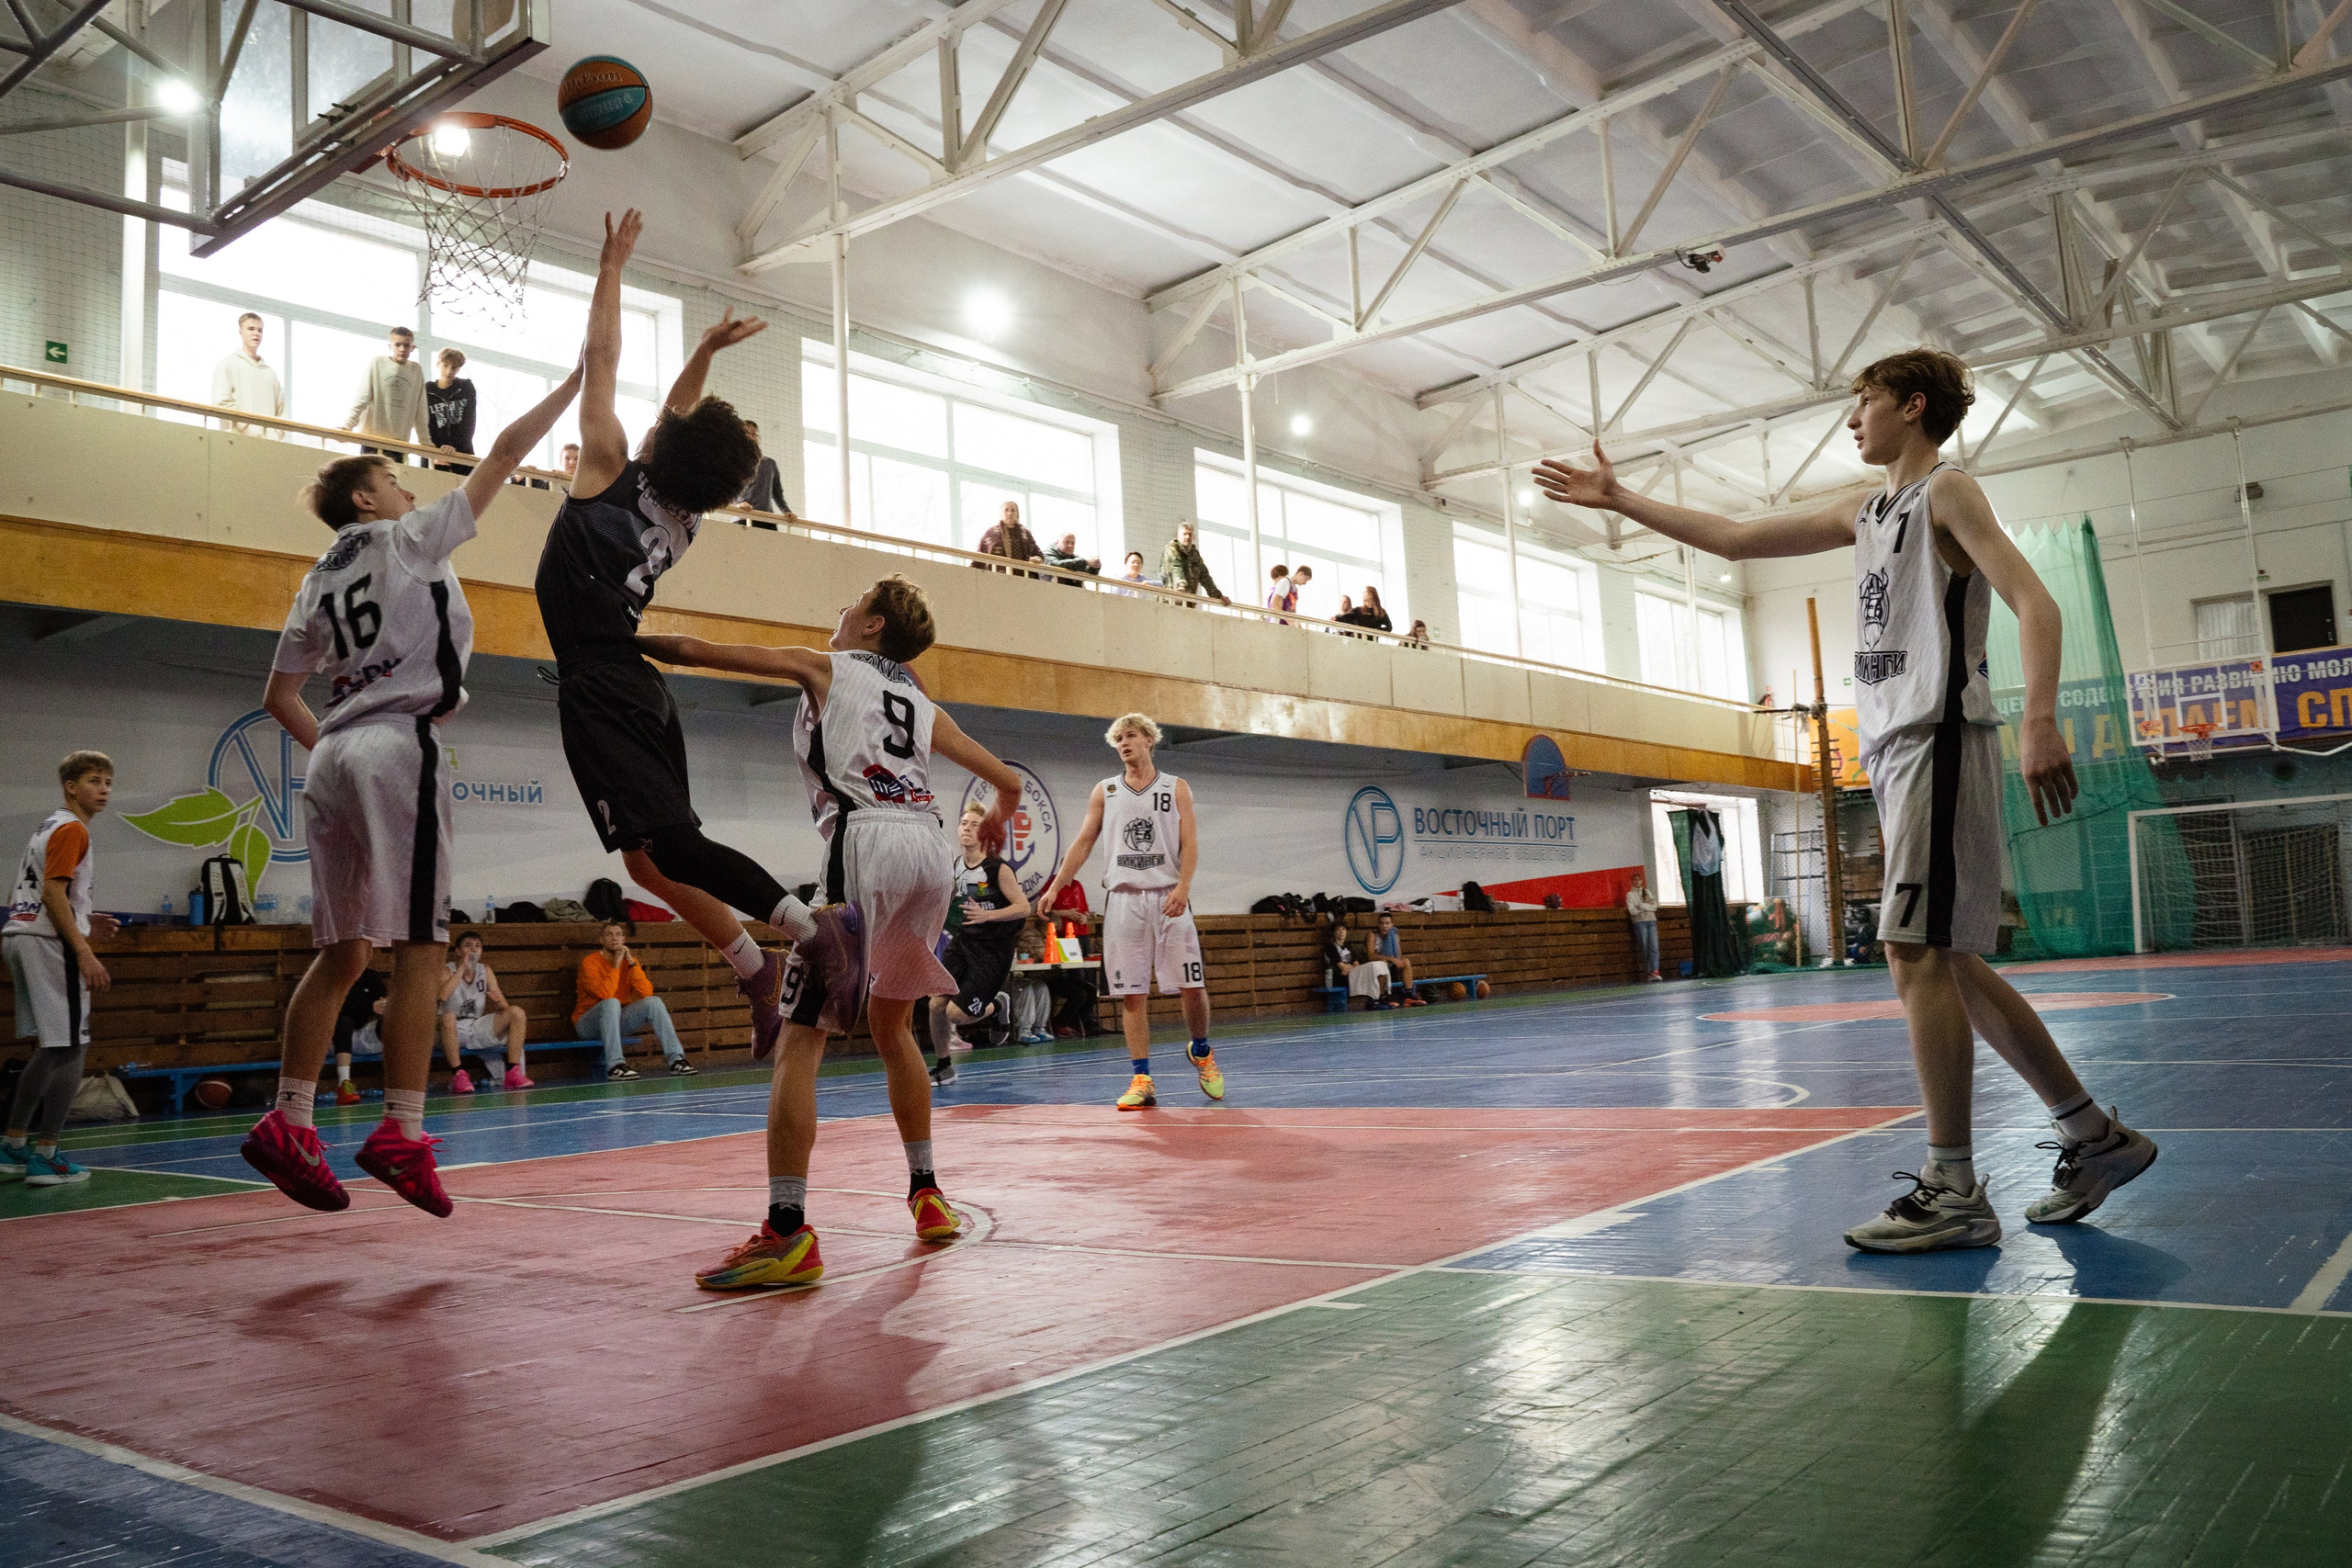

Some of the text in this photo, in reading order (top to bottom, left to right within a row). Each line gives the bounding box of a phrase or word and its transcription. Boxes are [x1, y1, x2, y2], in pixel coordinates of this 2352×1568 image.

[625, 525, 670, 597] 2
[319, 573, 382, 660] 16
[883, 690, 915, 760] 9
[451, 781, 542, 804] ОЧНЫЙ
[1023, 781, 1053, 833] БОКСА
[1153, 793, 1171, 812] 18
[597, 799, 617, 836] 2
[1413, 807, 1576, 840] ВОСТОЧНЫЙ ПОРТ
[1517, 847, 1577, 863] ОБЩЕСТВО
[1895, 884, 1922, 927] 7
[780, 966, 802, 1004] 9
[1182, 962, 1203, 983] 18
